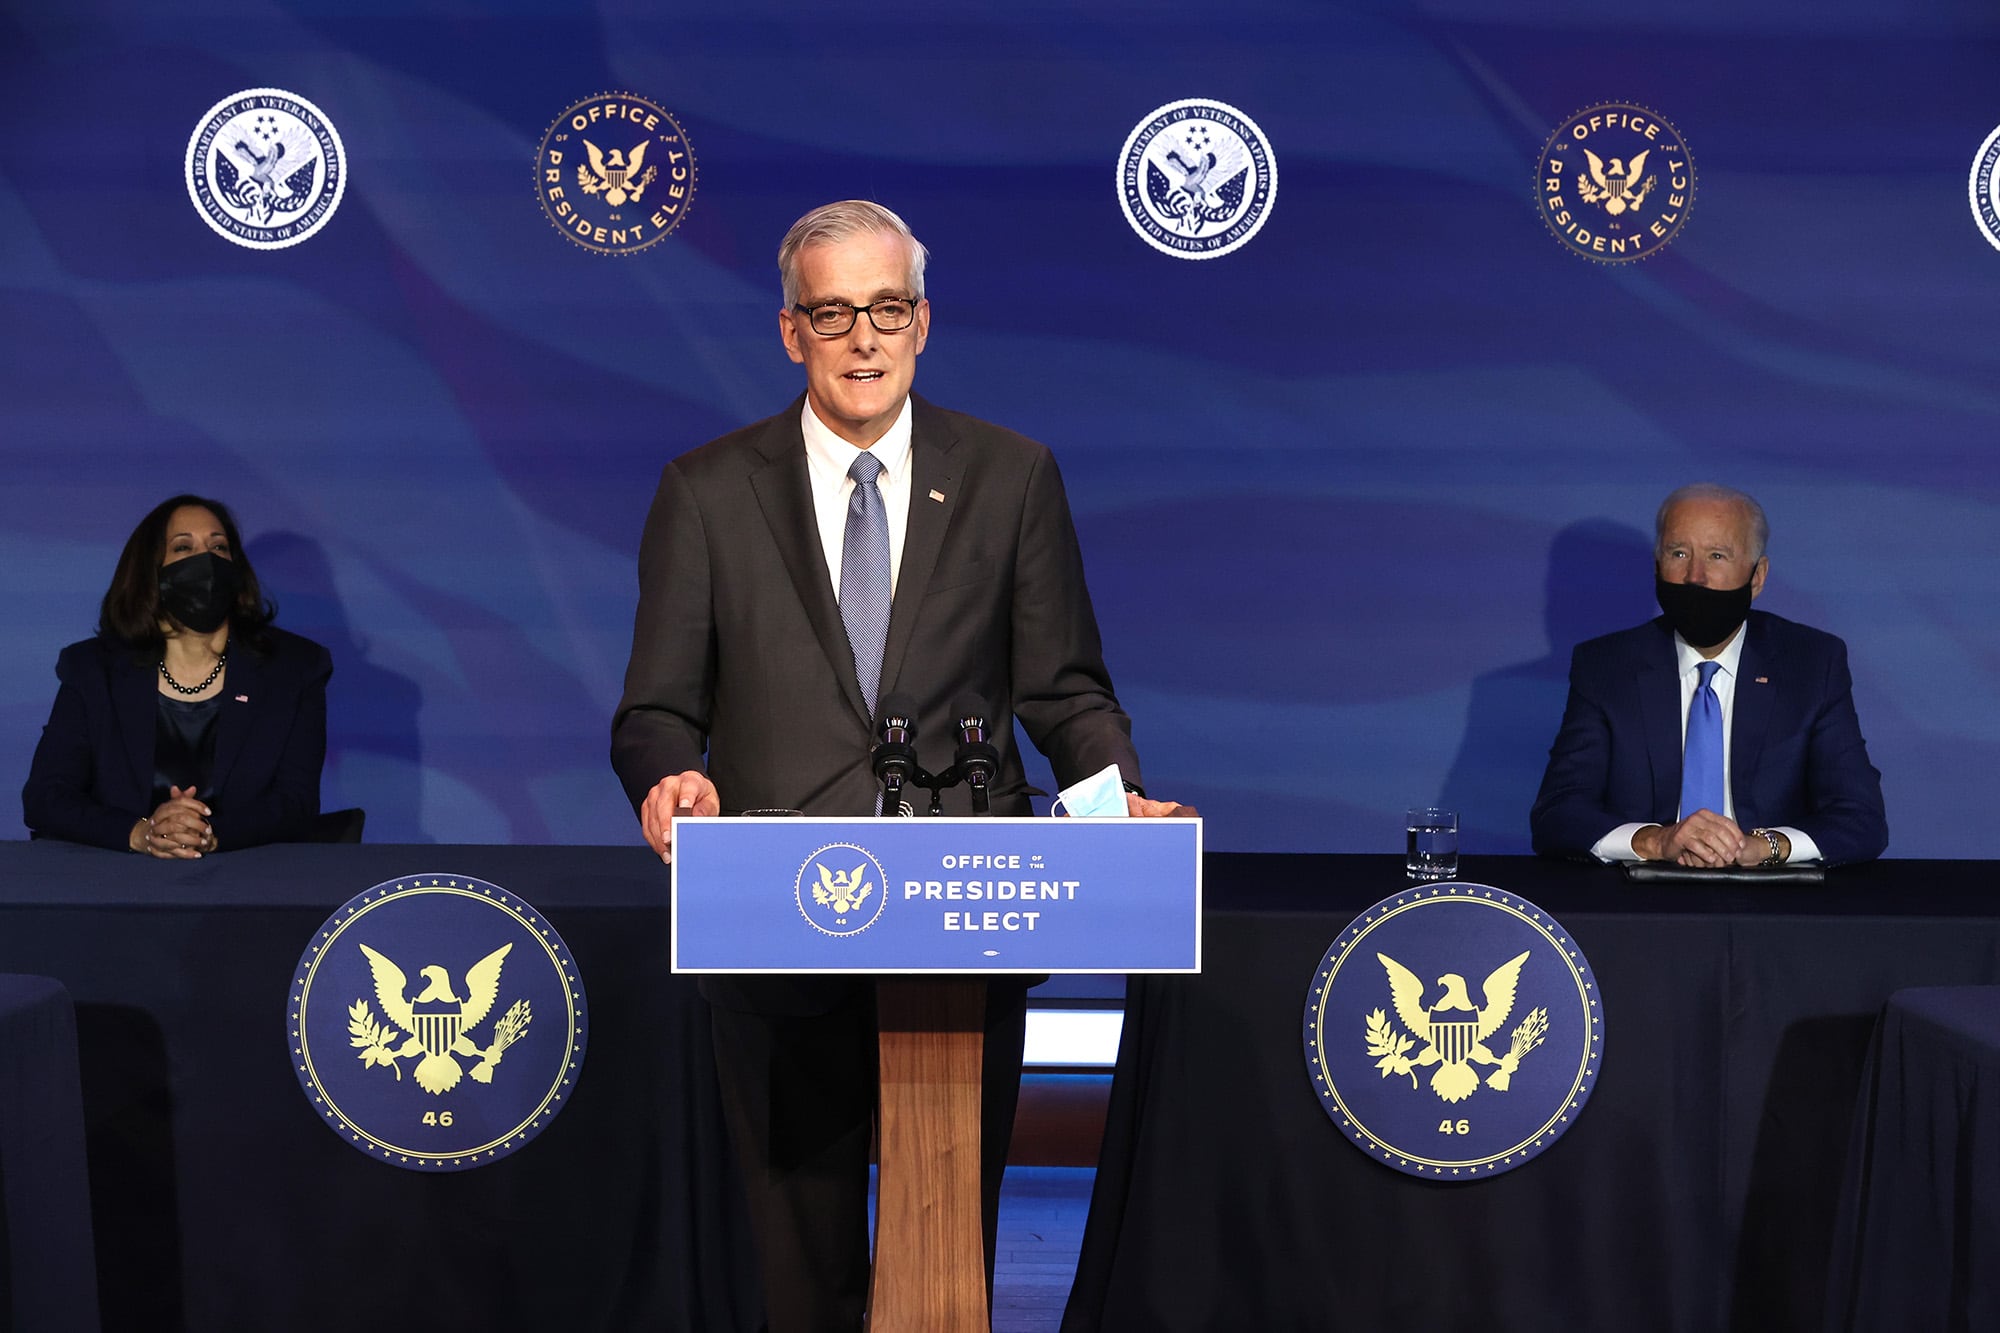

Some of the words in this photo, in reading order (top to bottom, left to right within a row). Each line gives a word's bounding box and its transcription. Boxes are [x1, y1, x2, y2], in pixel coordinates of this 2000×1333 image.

[555, 134, 569, 142] OF
[572, 104, 660, 132] OFFICE
[1572, 113, 1660, 140] OFFICE
[195, 107, 237, 175] DEPARTMENT
[242, 98, 257, 110] OF
[260, 98, 320, 130] VETERANS
[318, 130, 336, 179] AFFAIRS
[1126, 116, 1170, 185] DEPARTMENT
[1173, 108, 1189, 120] OF
[1193, 108, 1252, 140] VETERANS
[1248, 141, 1268, 189] AFFAIRS
[546, 150, 643, 244] PRESIDENT
[650, 150, 686, 229] ELECT
[1546, 159, 1642, 253] PRESIDENT
[1650, 160, 1686, 237] ELECT
[199, 187, 232, 231] UNITED
[232, 225, 273, 240] STATES
[277, 227, 292, 238] OF
[296, 192, 332, 232] AMERICA
[1130, 198, 1162, 241] UNITED
[1162, 235, 1203, 250] STATES
[1207, 237, 1222, 248] OF
[1226, 202, 1263, 242] AMERICA
[942, 855, 1021, 869] OFFICE
[904, 881, 1080, 900] PRESIDENT
[943, 912, 1040, 930] ELECT
[422, 1111, 453, 1126] 46
[1438, 1119, 1470, 1135] 46
